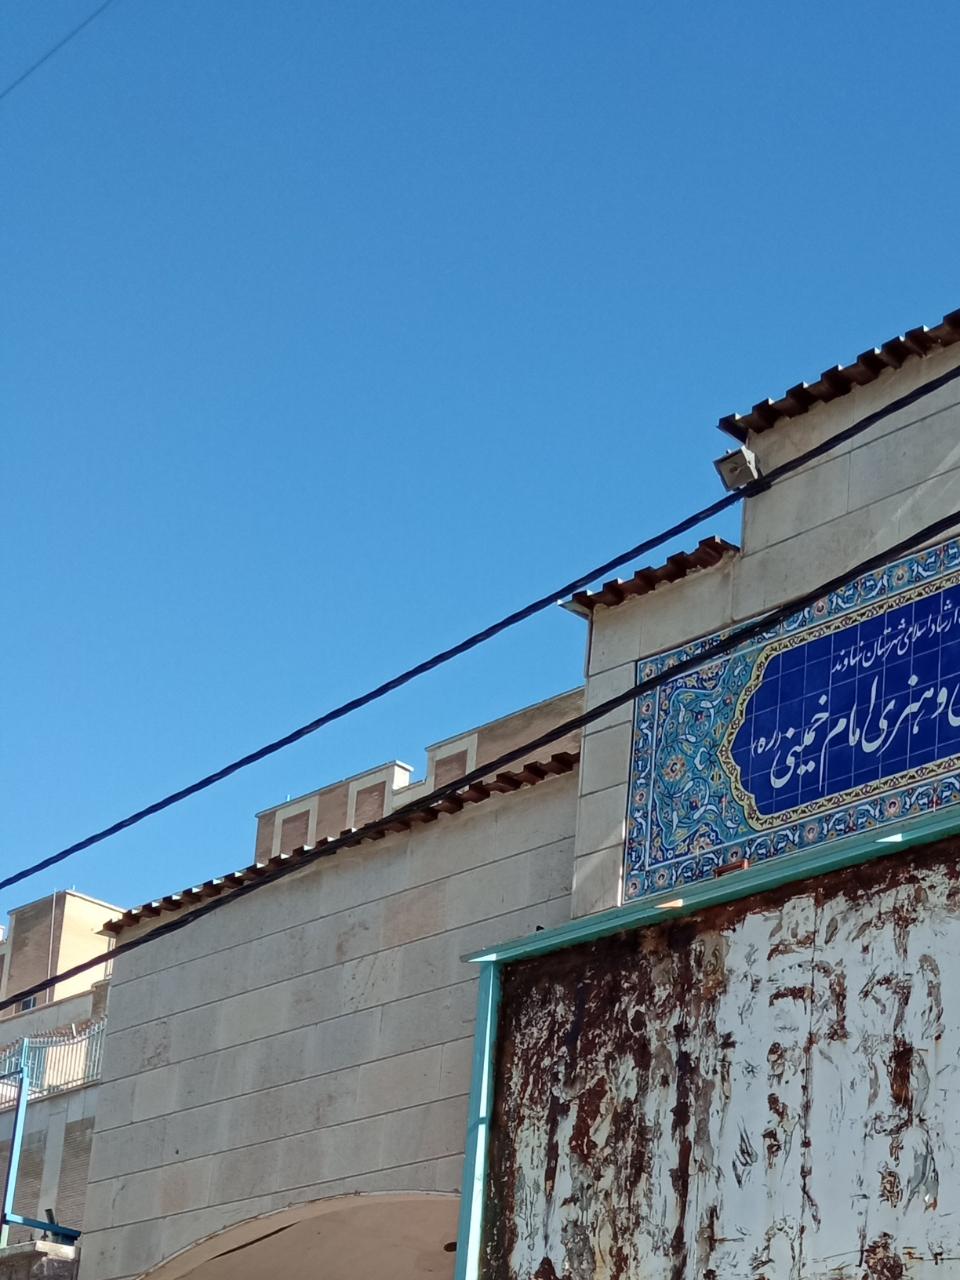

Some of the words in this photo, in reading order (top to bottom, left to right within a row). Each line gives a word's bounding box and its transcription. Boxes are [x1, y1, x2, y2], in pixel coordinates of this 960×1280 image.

[898, 613, 932, 656] اسلامی
[929, 600, 959, 638] ارشاد
[832, 641, 863, 673] نهاوند
[862, 618, 906, 668] شهرستان
[861, 674, 935, 758] هنری
[931, 687, 948, 718] و
[770, 694, 830, 789] خمینی
[818, 675, 879, 793] امام
